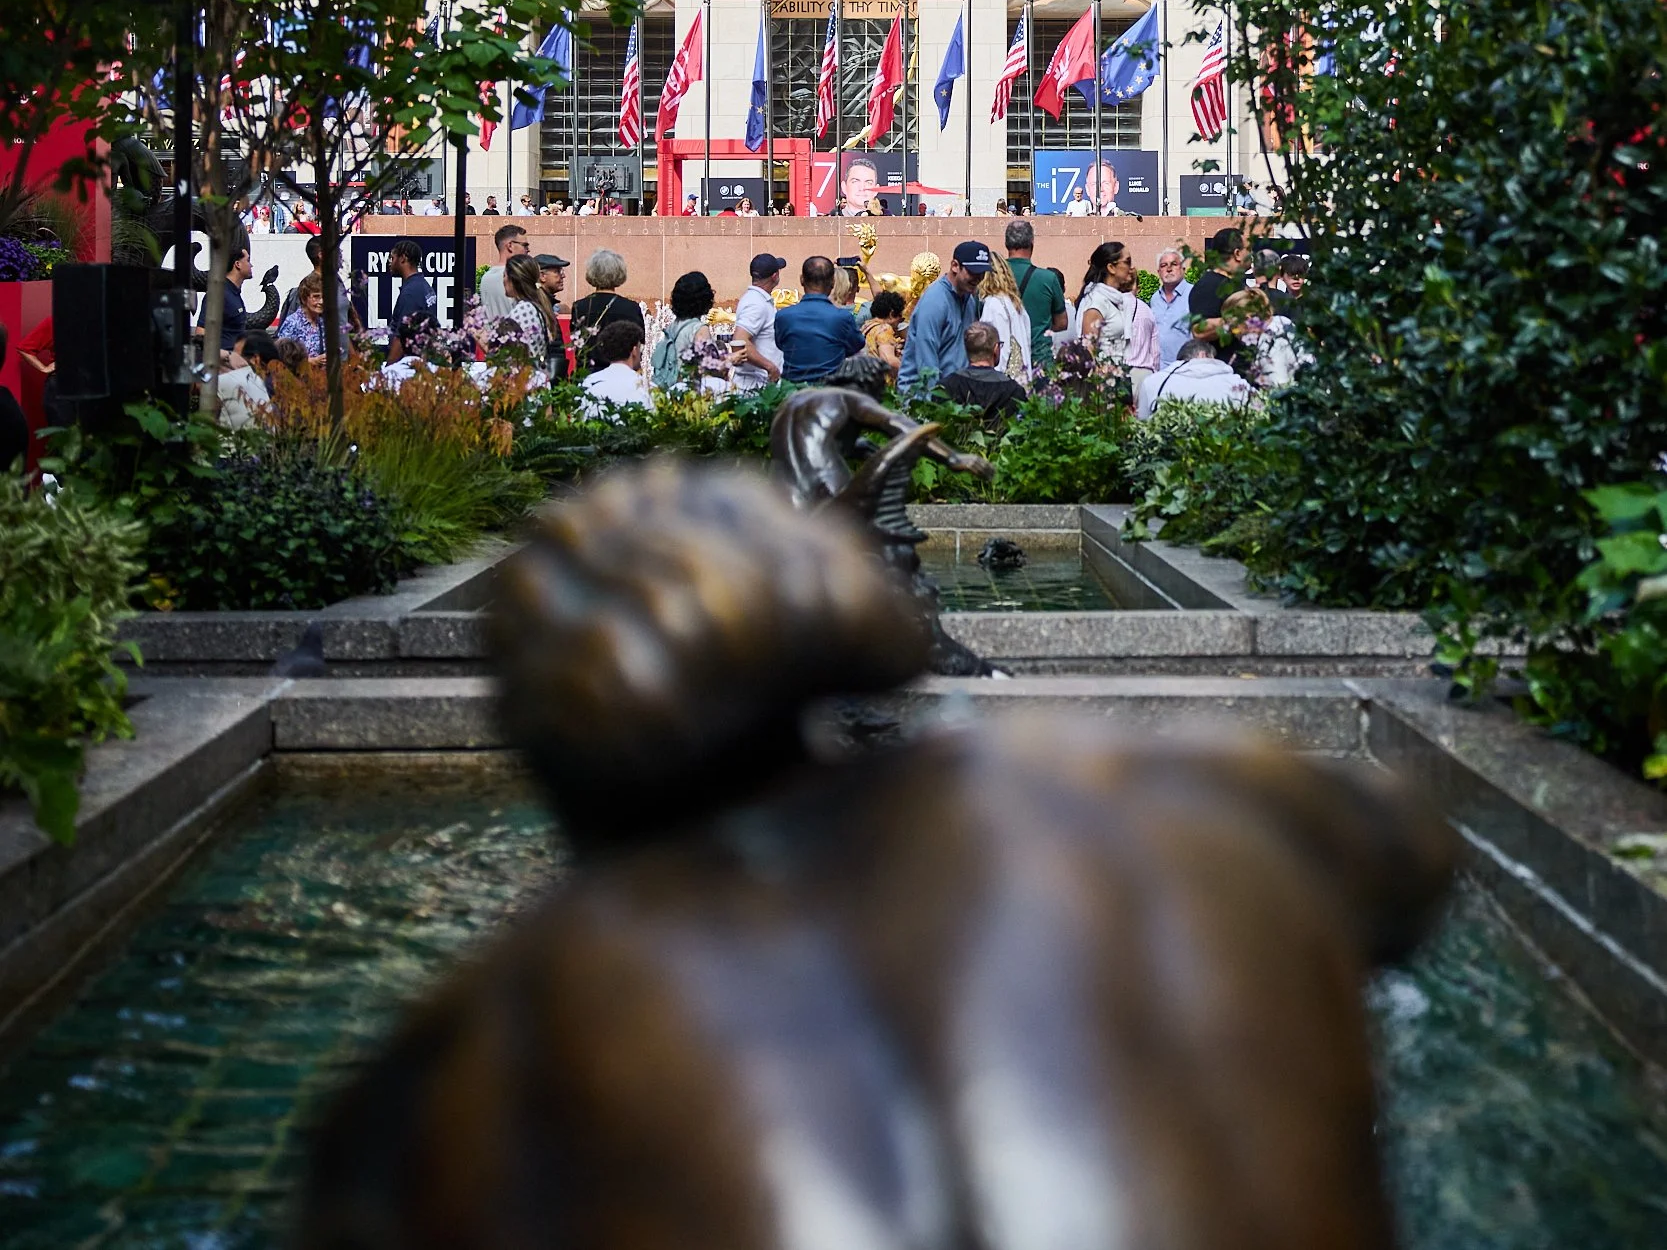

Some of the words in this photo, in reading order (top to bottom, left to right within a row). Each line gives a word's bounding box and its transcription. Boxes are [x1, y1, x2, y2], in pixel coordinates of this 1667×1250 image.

[771, 1, 825, 13] TABILITY
[850, 1, 872, 13] THY
[878, 1, 917, 13] TIMS
[1051, 167, 1081, 204] i7
[425, 251, 456, 273] CUP
[367, 276, 455, 329] LIE
